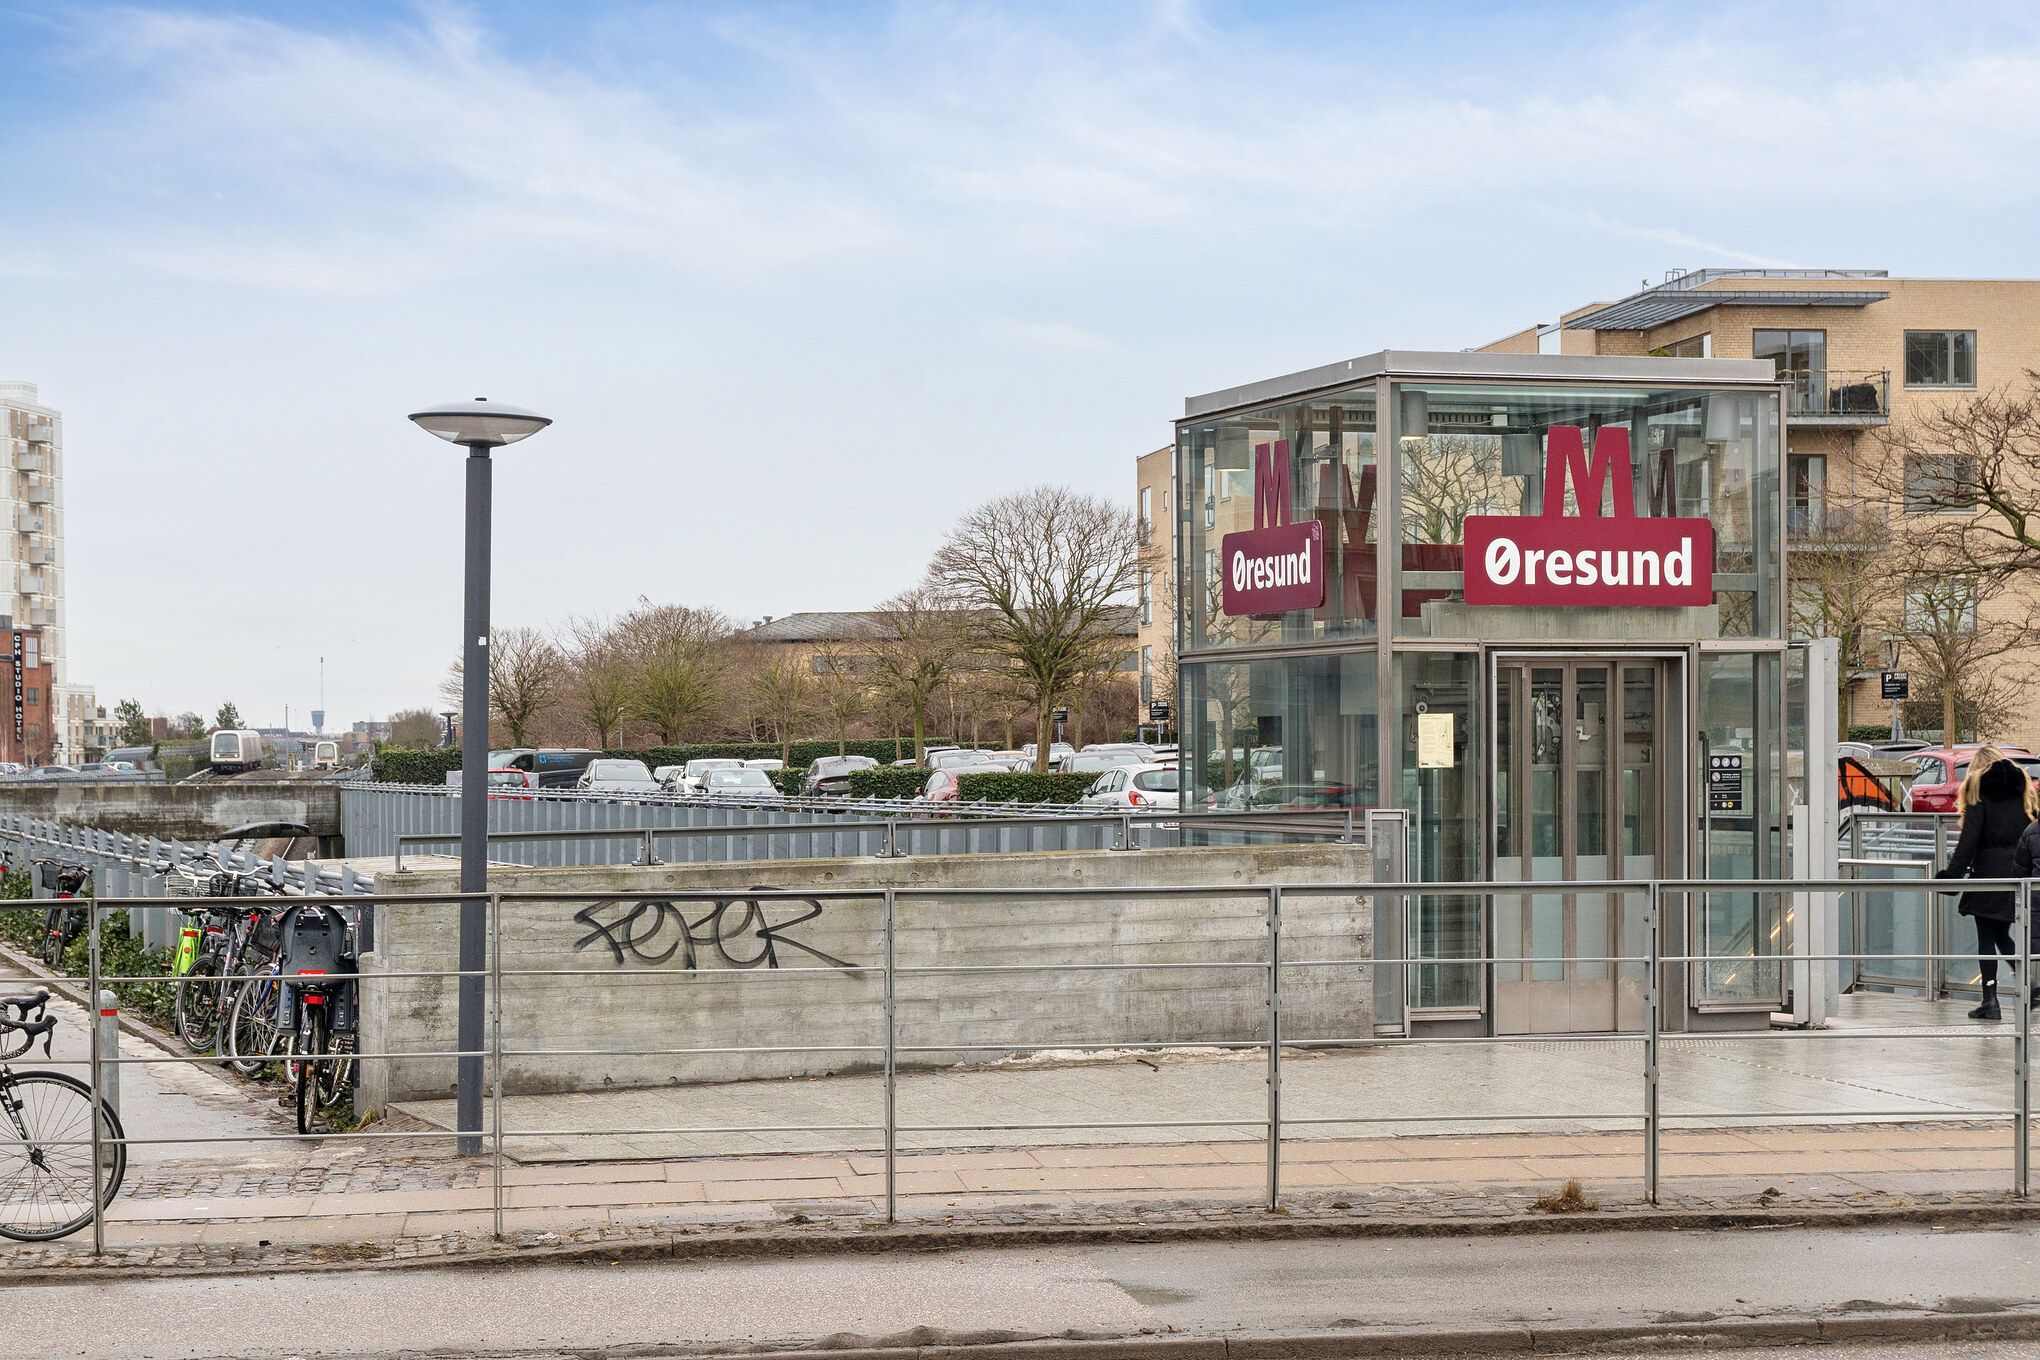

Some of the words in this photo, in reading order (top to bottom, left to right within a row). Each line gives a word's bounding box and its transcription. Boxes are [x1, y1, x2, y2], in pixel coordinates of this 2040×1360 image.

[1254, 438, 1291, 531] M
[1542, 425, 1635, 518] M
[1232, 537, 1311, 592] Øresund
[1484, 537, 1693, 586] Øresund
[1885, 674, 1892, 682] P
[15, 706, 23, 740] HOTEL
